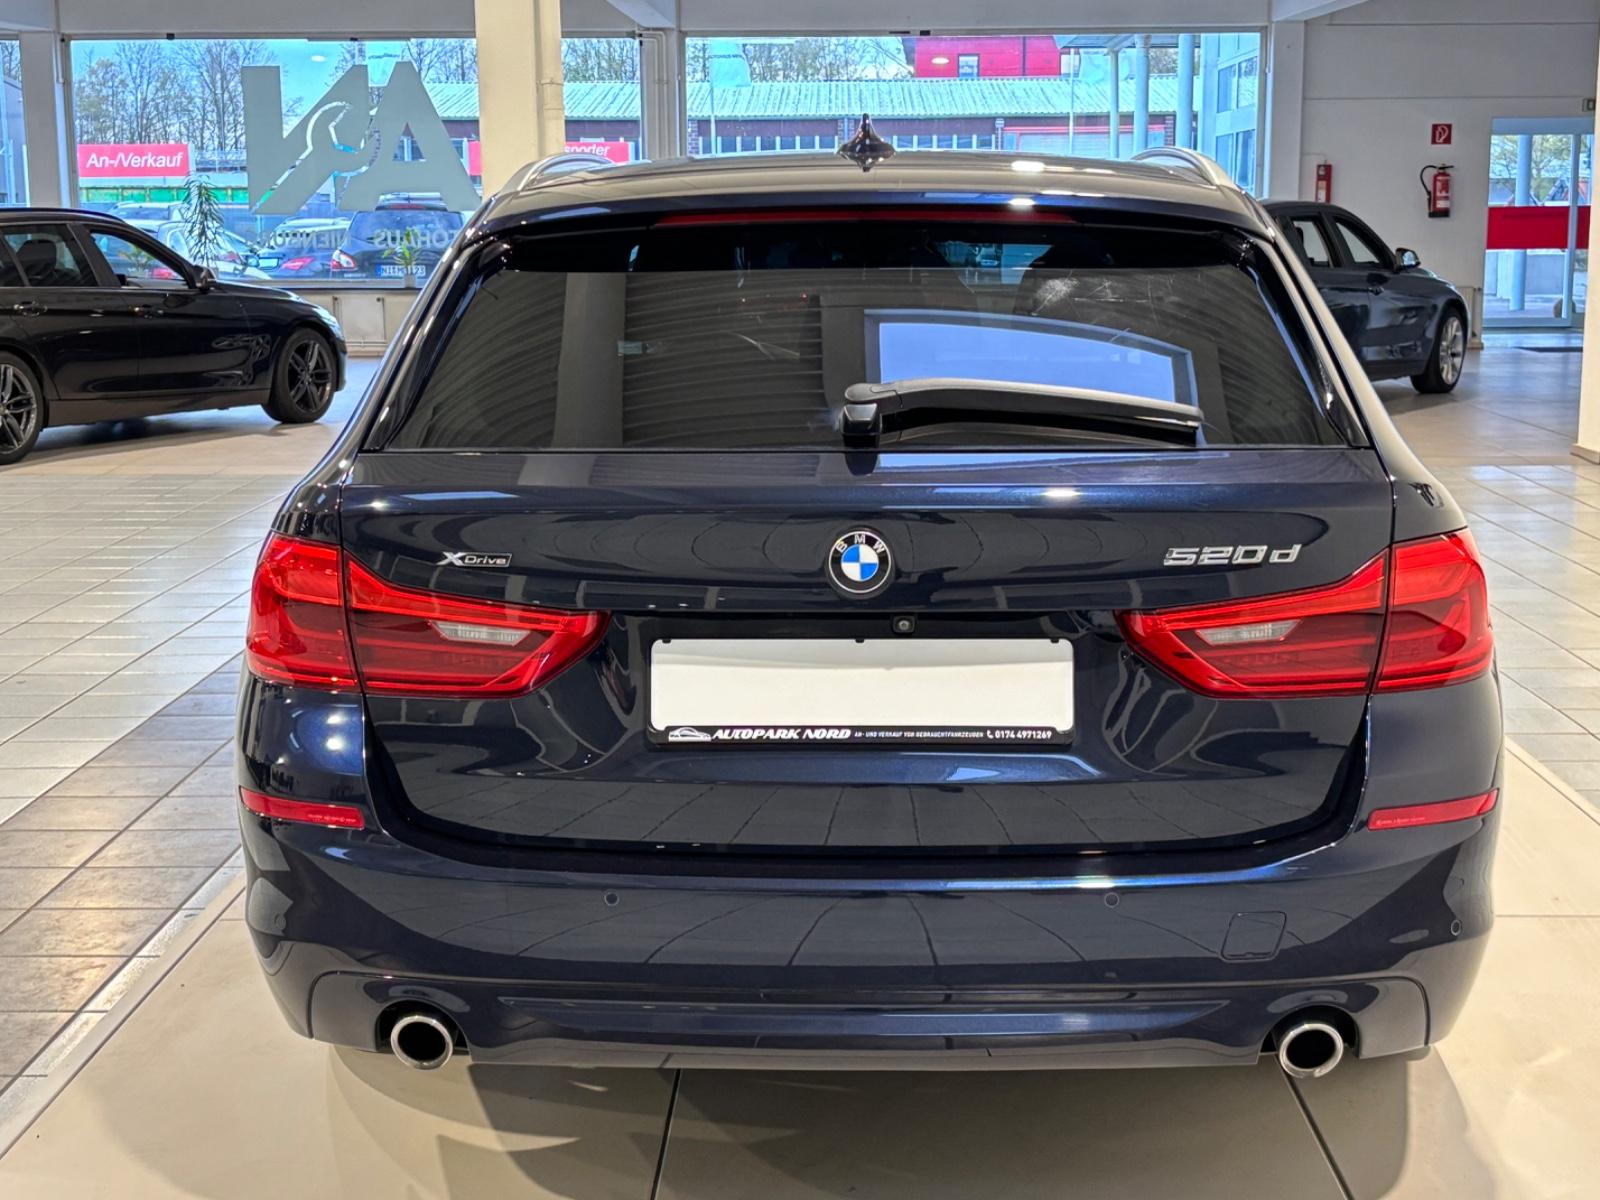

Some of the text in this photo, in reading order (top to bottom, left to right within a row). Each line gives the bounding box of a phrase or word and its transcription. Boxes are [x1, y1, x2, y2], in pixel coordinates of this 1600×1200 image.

[86, 152, 183, 168] An-/Verkauf
[835, 533, 885, 554] BMW
[712, 728, 801, 740] AUTOPARK
[802, 728, 852, 740] NORD
[995, 730, 1015, 739] 0174
[1016, 730, 1052, 739] 4971269
